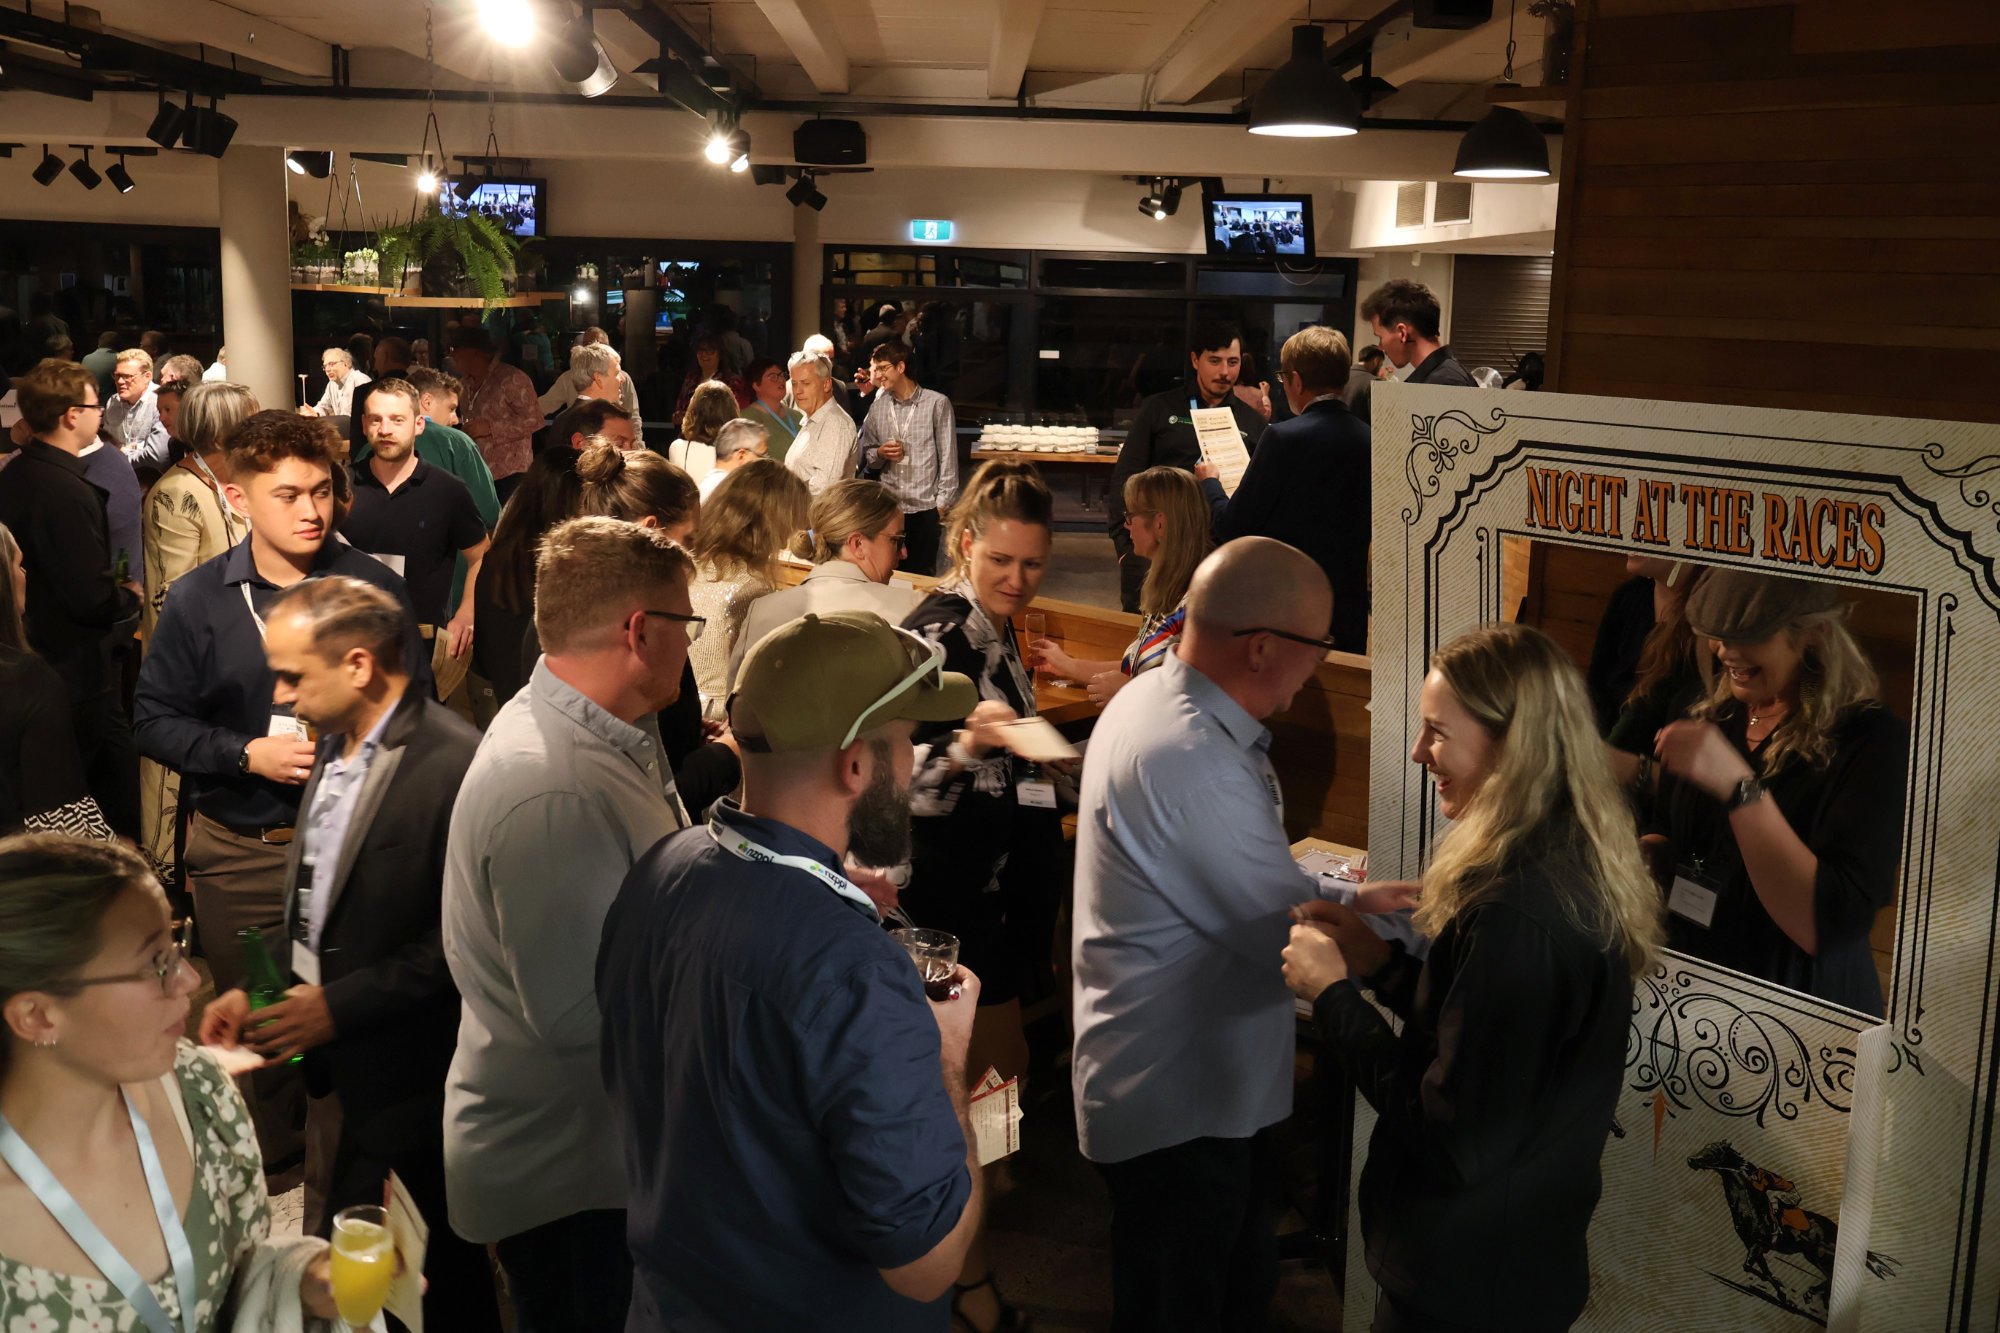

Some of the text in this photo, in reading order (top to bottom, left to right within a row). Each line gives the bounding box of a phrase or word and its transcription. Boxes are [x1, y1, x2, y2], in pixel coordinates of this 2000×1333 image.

[1525, 466, 1885, 575] NIGHT AT THE RACES
[824, 870, 847, 890] nzppi
